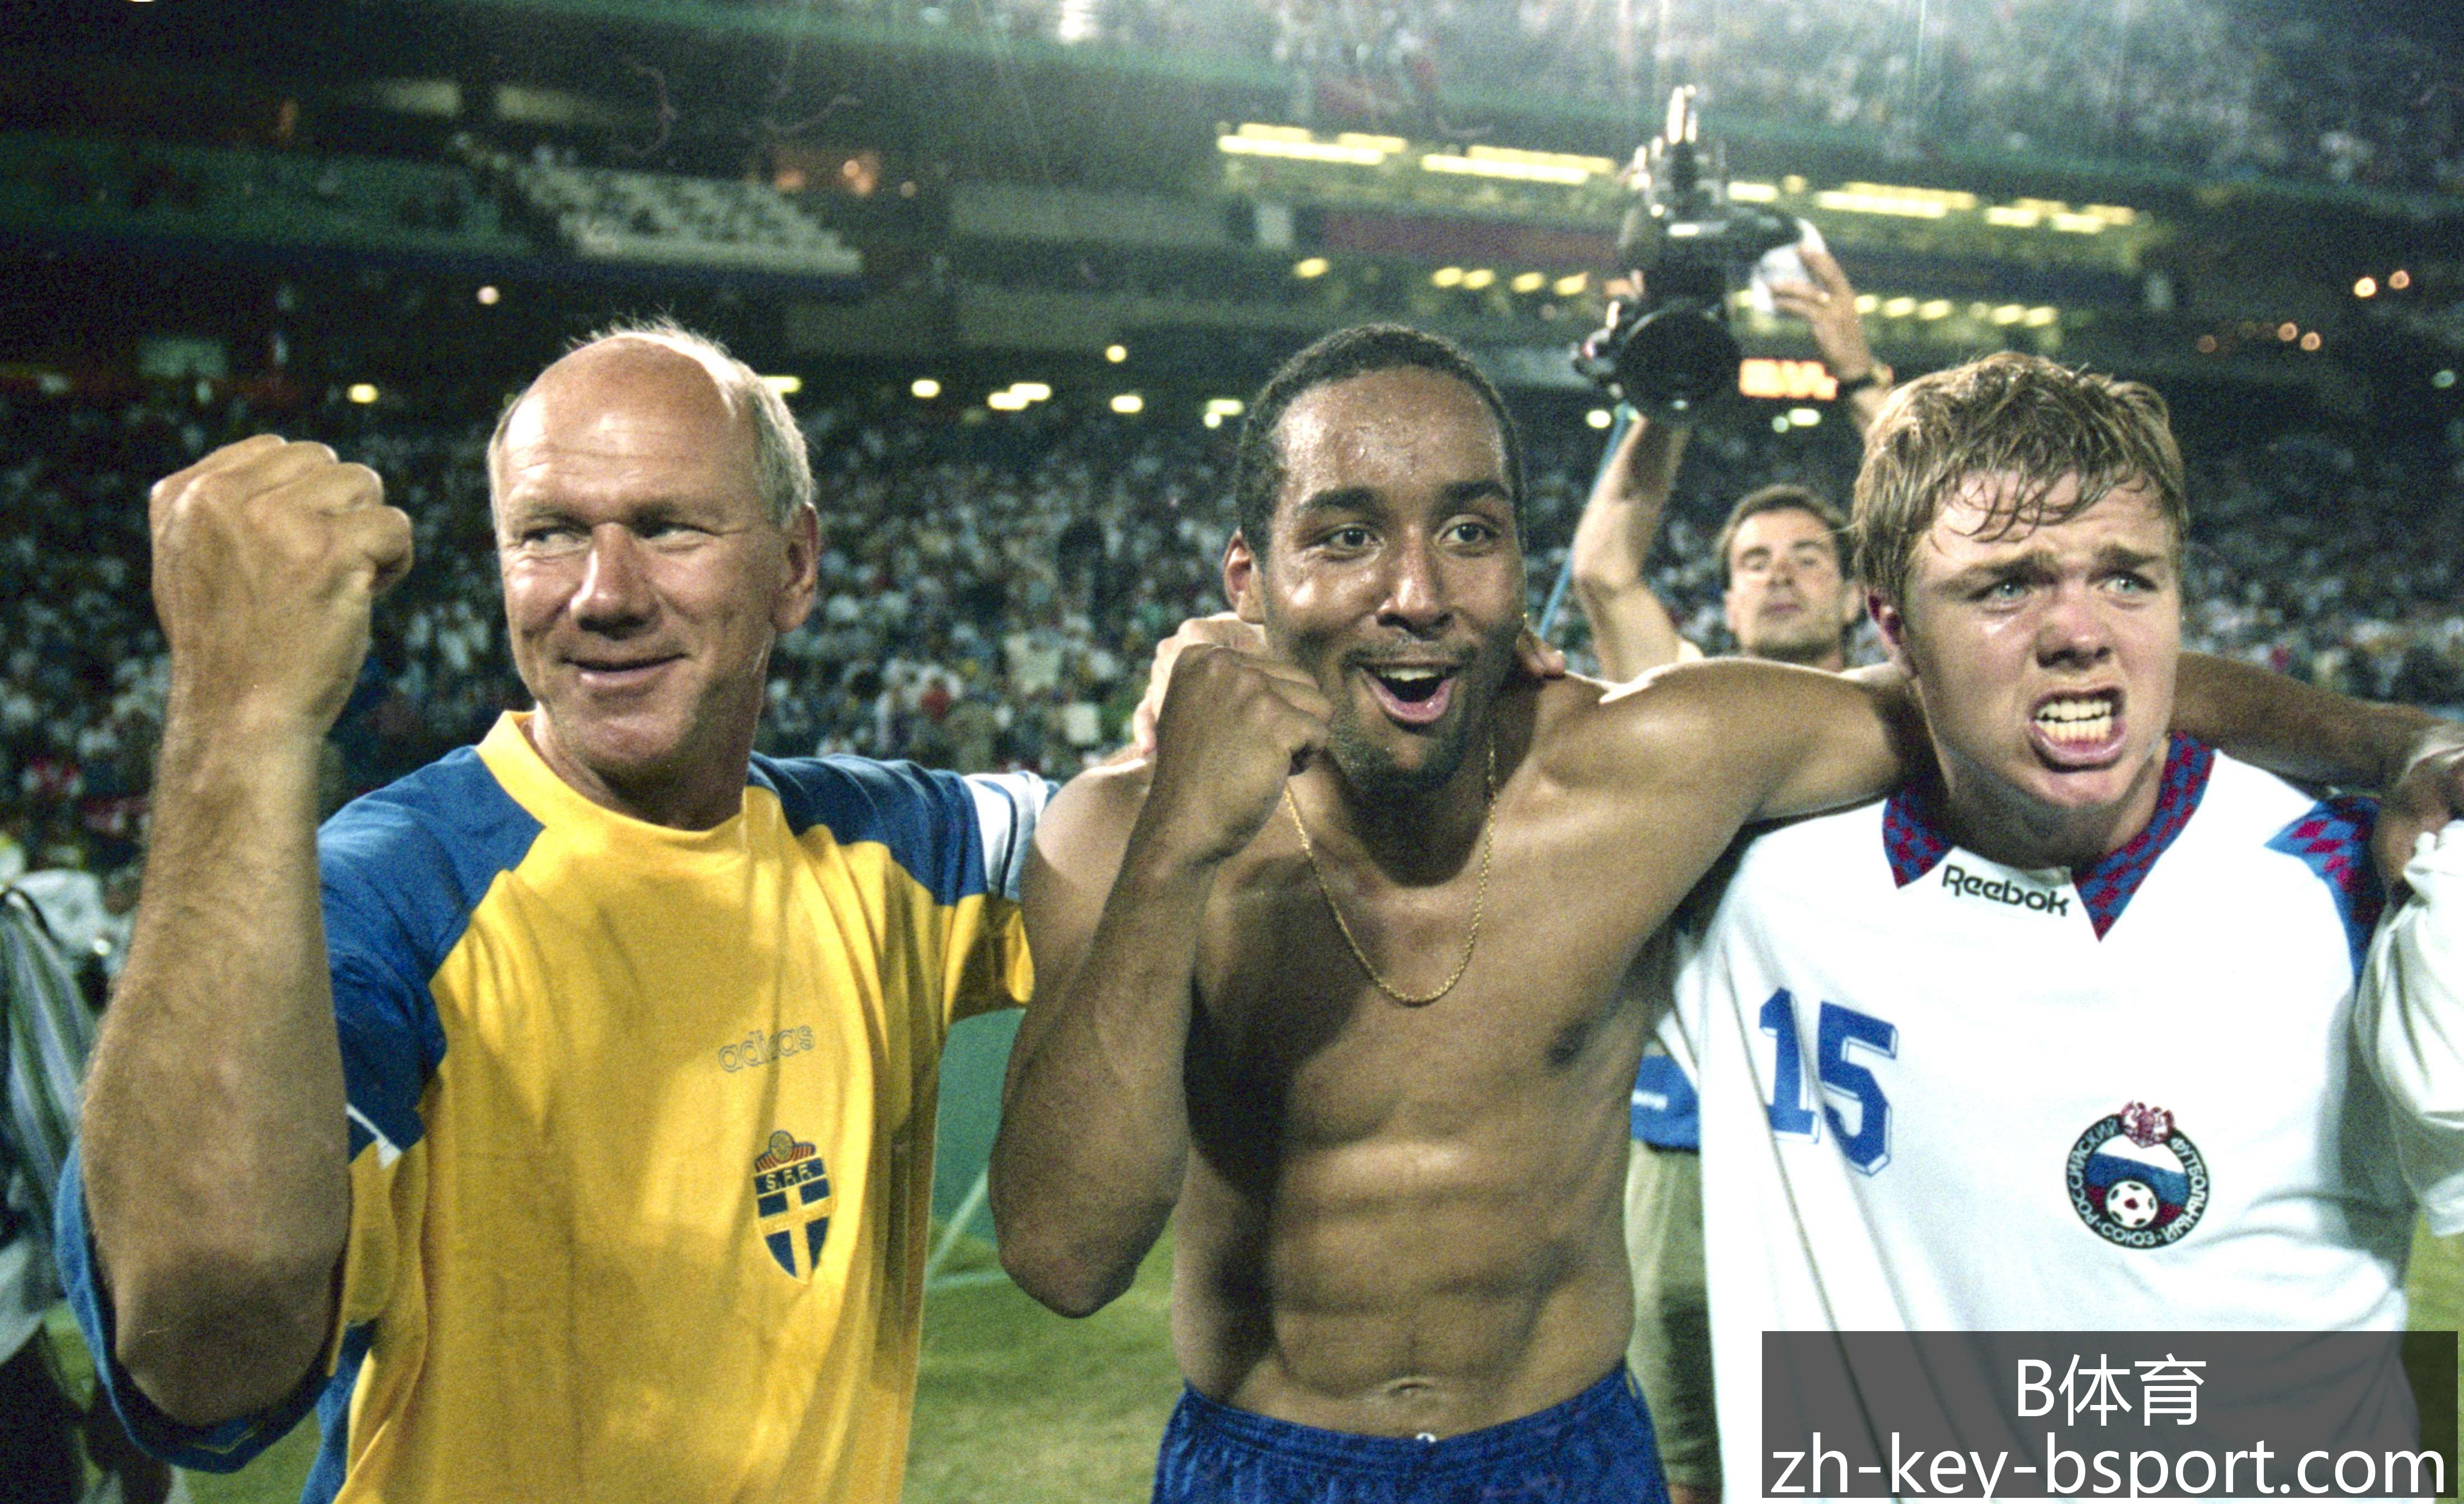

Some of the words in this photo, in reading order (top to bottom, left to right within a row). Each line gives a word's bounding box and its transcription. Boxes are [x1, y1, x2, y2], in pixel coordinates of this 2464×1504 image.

[1941, 864, 2070, 916] Reebok
[1759, 986, 1898, 1177] 15
[2100, 1221, 2157, 1246] СОЮЗ
